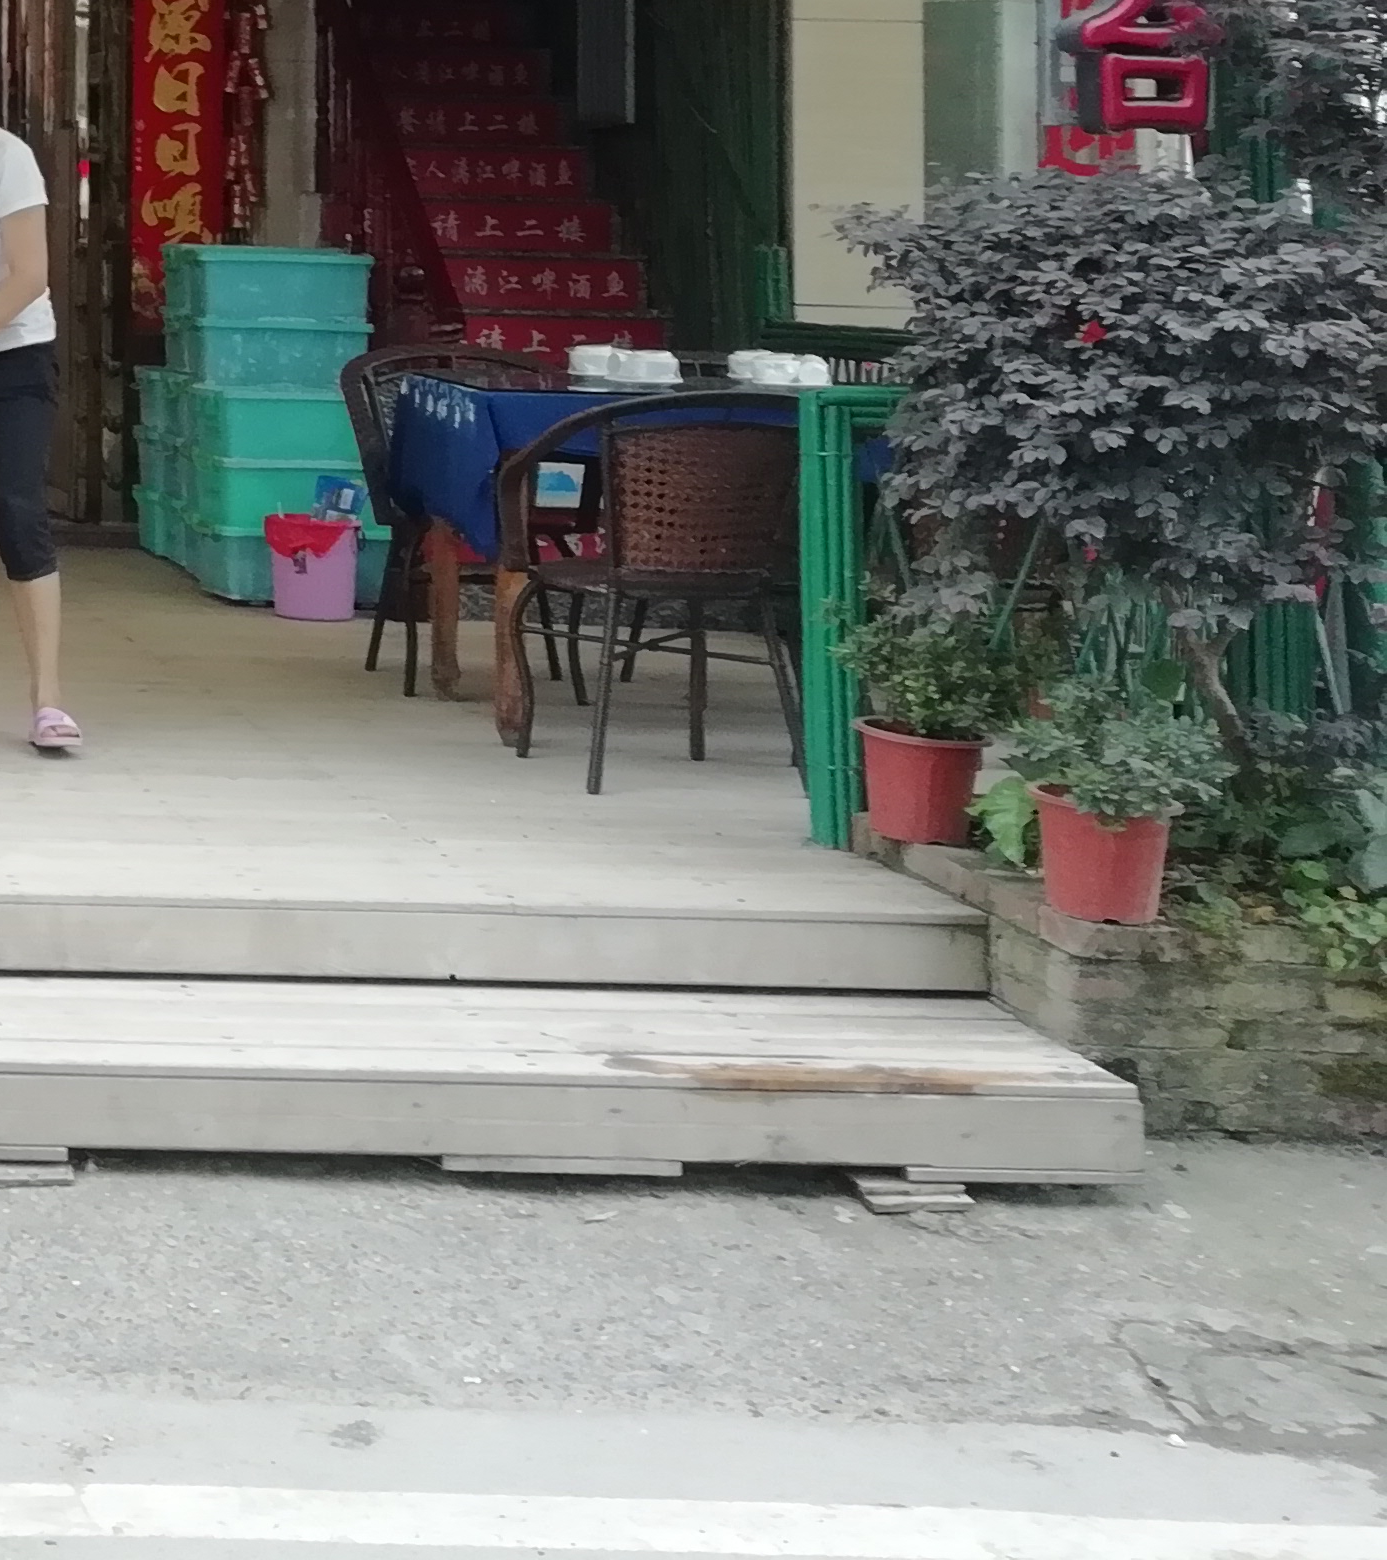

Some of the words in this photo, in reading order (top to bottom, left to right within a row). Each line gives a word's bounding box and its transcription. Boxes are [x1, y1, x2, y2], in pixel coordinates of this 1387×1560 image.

[431, 209, 587, 243] 请上二楼
[464, 264, 629, 300] 漓江啤酒鱼
